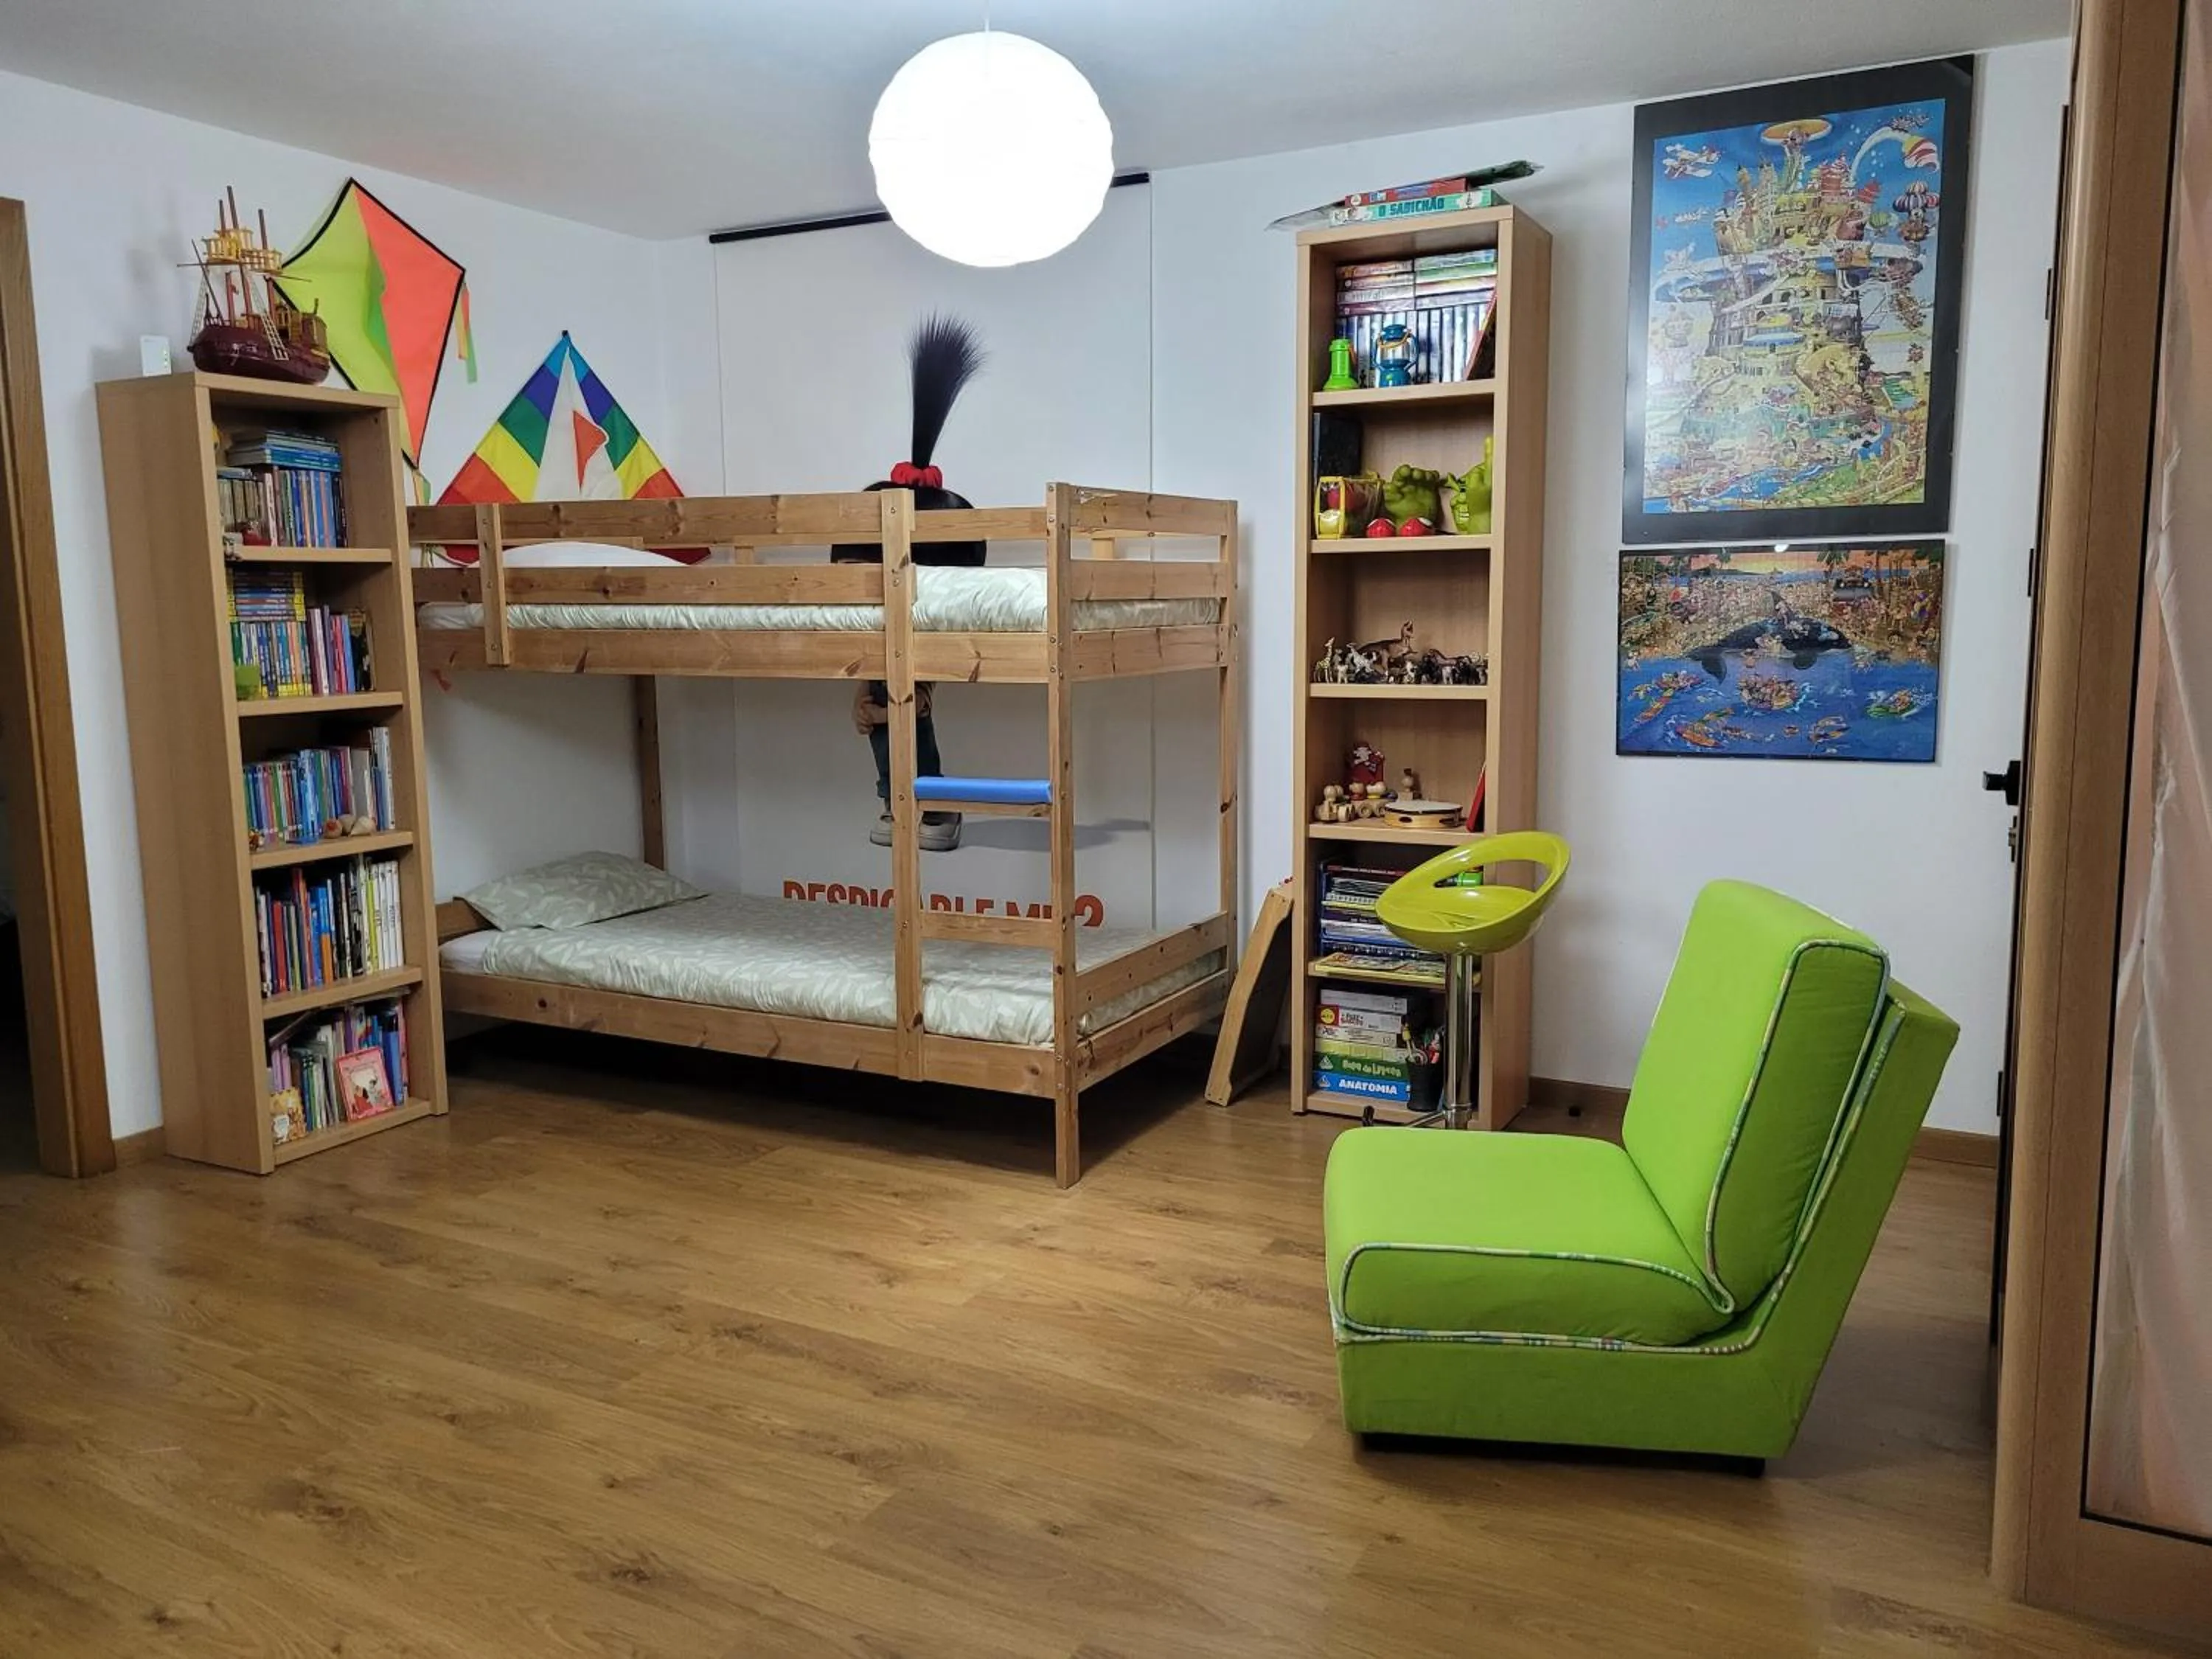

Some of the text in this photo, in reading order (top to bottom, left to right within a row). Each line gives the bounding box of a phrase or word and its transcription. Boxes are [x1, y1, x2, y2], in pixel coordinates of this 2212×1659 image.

[1378, 204, 1386, 217] O
[1389, 196, 1445, 216] SABICHÃO
[1338, 1079, 1397, 1095] ANATOMIA
